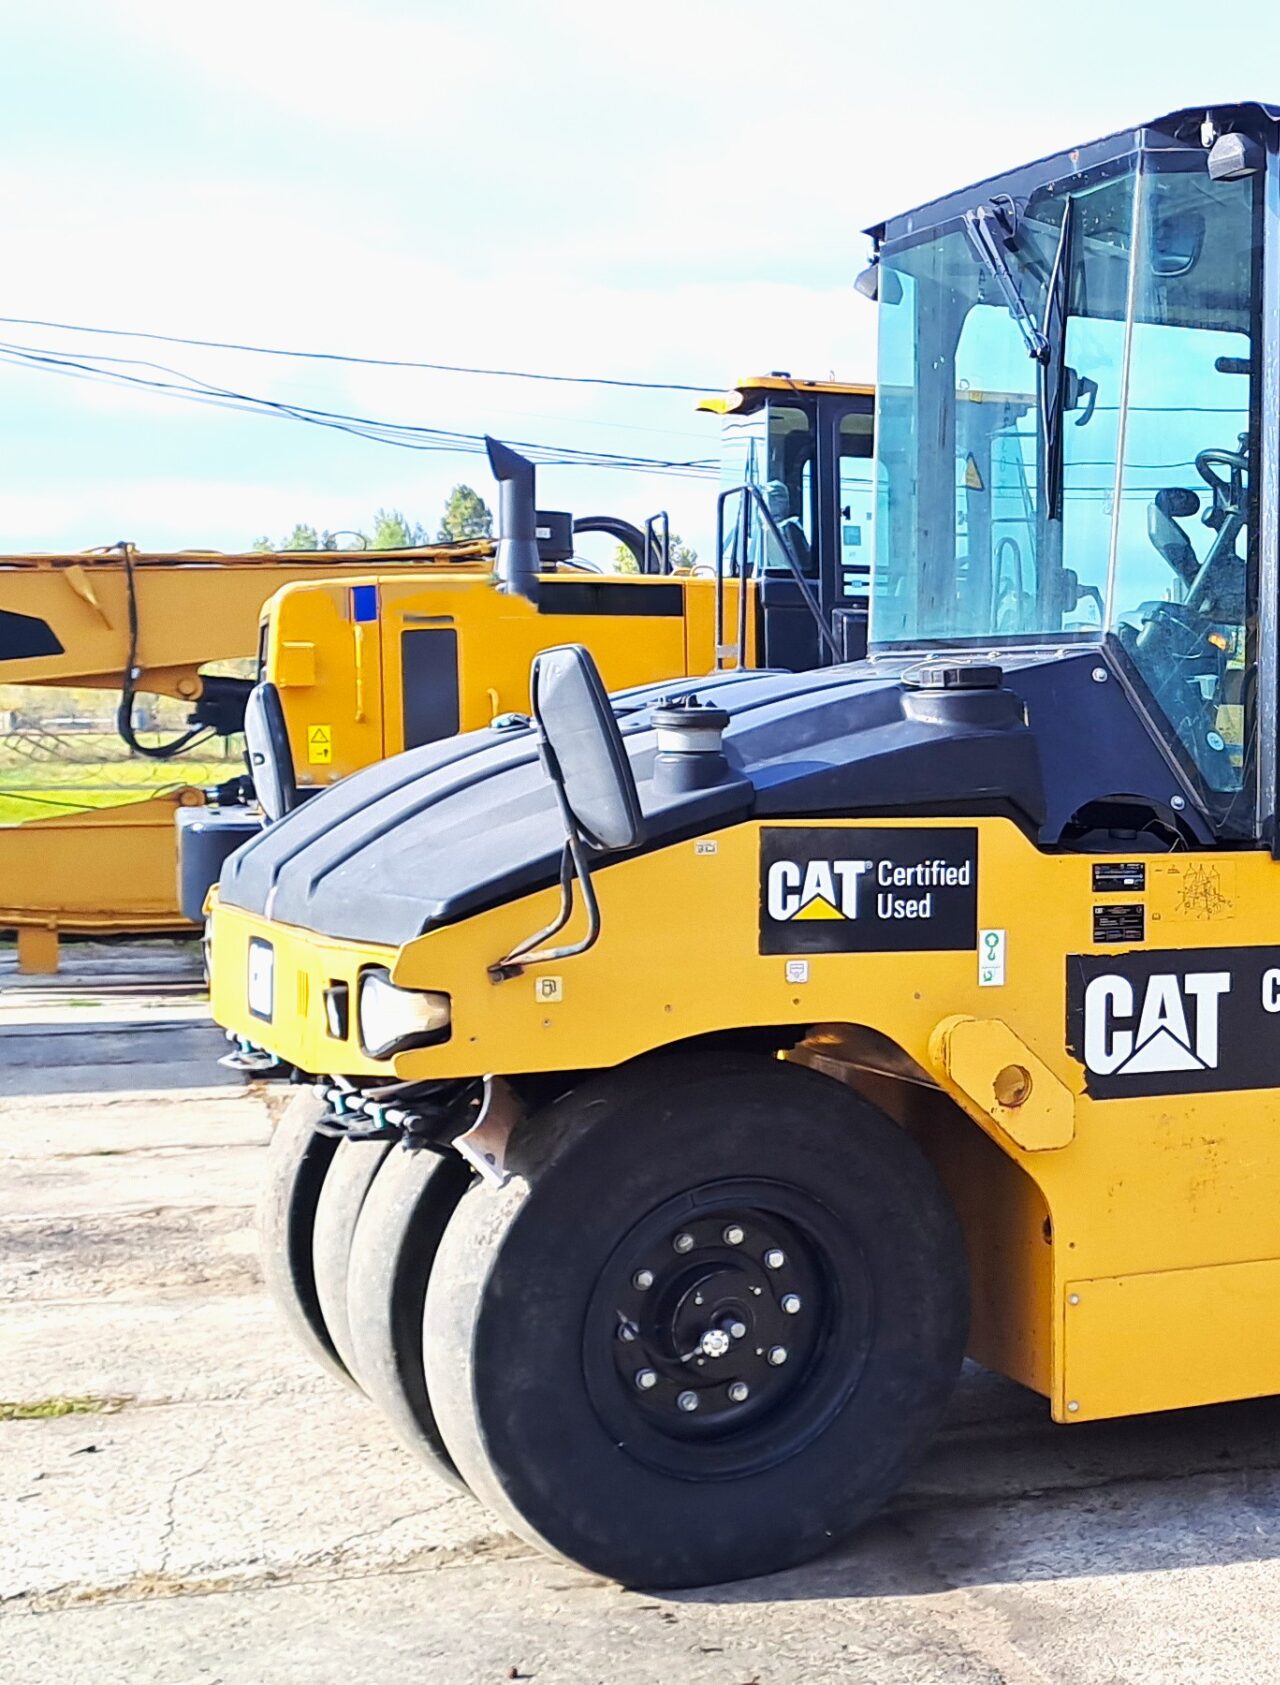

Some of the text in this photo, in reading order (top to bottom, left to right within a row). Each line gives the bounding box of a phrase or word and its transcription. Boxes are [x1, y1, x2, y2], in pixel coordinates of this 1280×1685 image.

[877, 860, 970, 887] Certified
[877, 893, 931, 919] Used
[1085, 972, 1230, 1076] CAT
